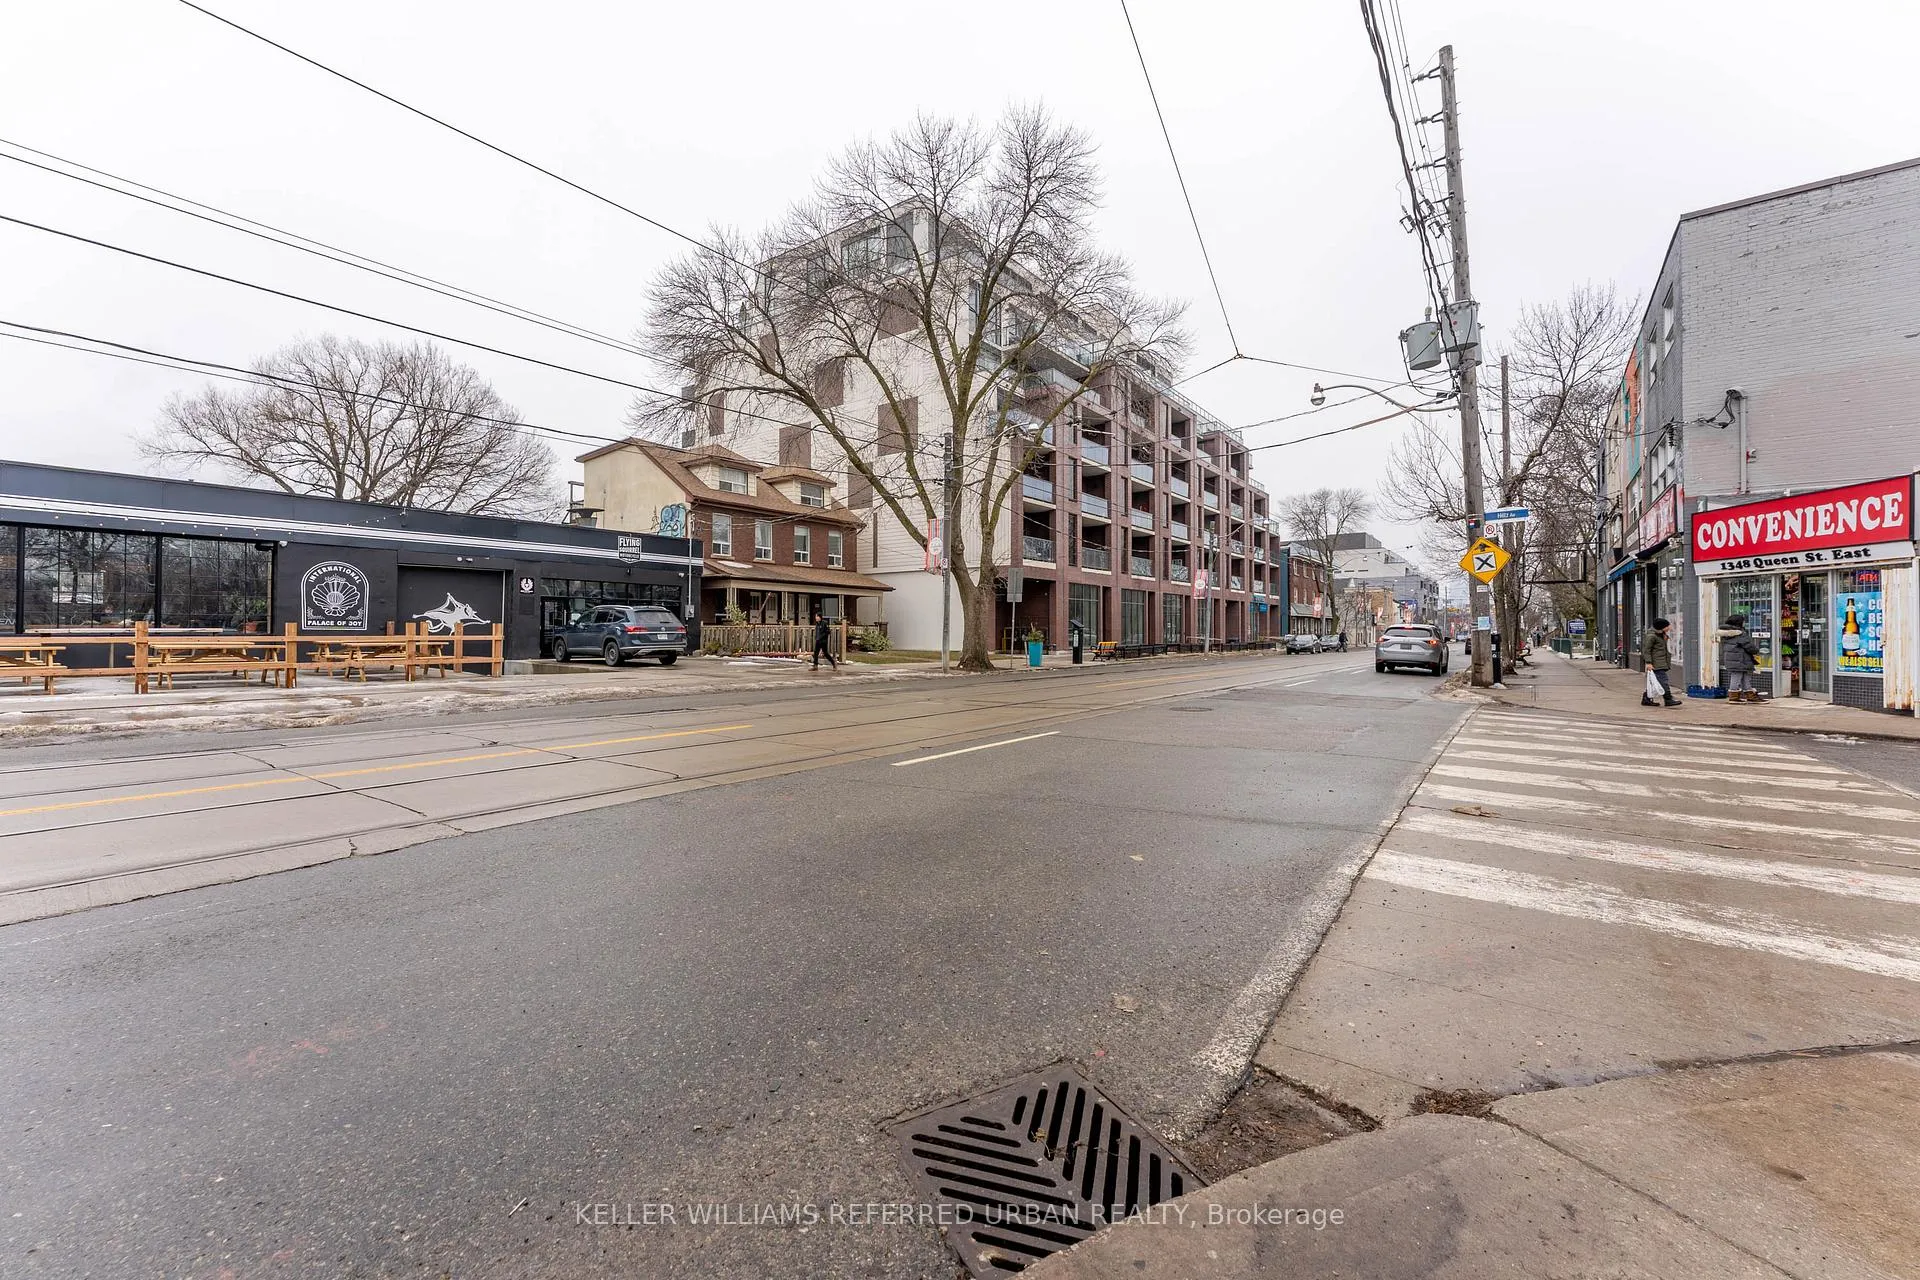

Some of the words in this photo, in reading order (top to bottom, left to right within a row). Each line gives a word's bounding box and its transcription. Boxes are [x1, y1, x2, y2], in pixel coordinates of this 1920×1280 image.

[1697, 491, 1904, 550] CONVENIENCE
[619, 537, 641, 547] FLYING
[1720, 559, 1751, 571] 1348
[1753, 555, 1799, 569] Queen
[1805, 551, 1828, 563] St.
[1832, 547, 1872, 560] East
[308, 565, 362, 584] INTERNATIONAL
[1868, 599, 1882, 610] CO
[1868, 612, 1883, 624] BE
[1868, 626, 1882, 637] SO
[1868, 640, 1882, 651] HE
